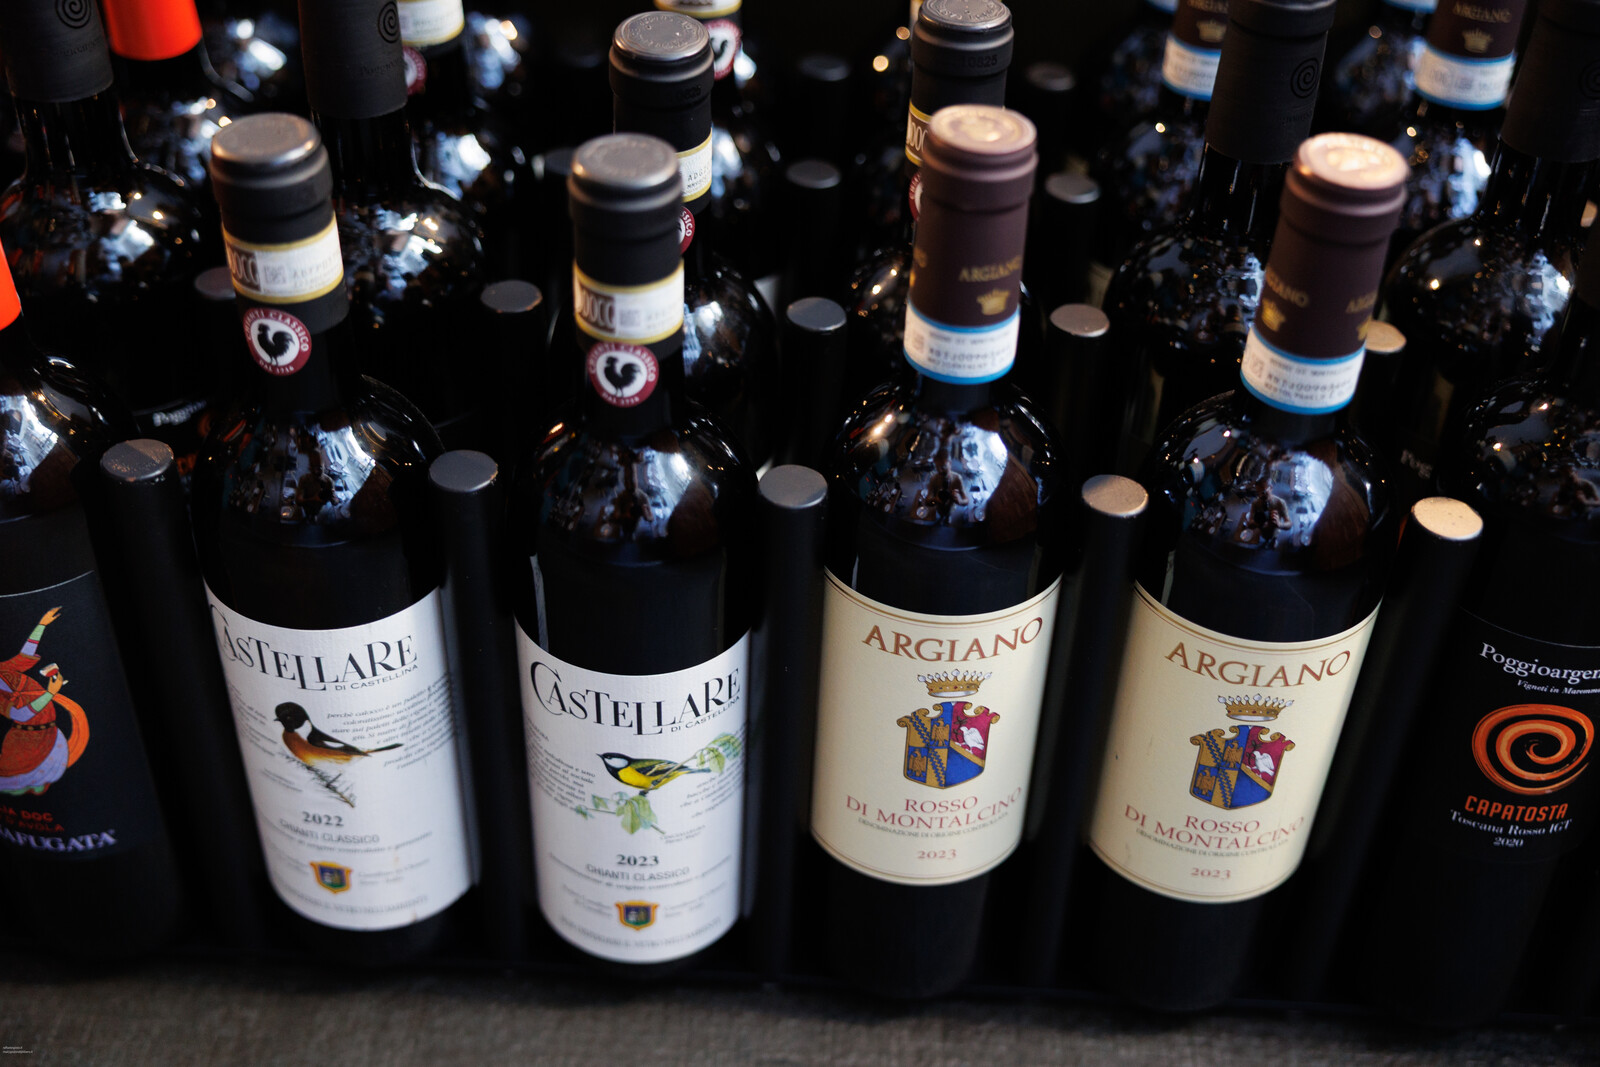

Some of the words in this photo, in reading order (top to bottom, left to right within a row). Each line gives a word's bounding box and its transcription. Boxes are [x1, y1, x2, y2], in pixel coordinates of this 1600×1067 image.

[269, 310, 310, 352] CLASSICO
[619, 343, 657, 382] CLASSICO
[862, 617, 1043, 662] ARGIANO
[1165, 641, 1351, 688] ARGIANO
[350, 664, 419, 690] CASTELLINA
[1517, 679, 1548, 693] Vigneti
[1550, 686, 1559, 694] in
[670, 725, 681, 733] DI
[685, 695, 741, 729] CASTELLINA
[21, 810, 54, 823] DOC
[846, 795, 868, 816] DI
[877, 787, 1022, 829] MONTALCINO
[905, 796, 978, 814] ROSSO
[1464, 795, 1569, 822] CAPATOSTA
[279, 818, 319, 840] CHIANTI
[322, 833, 381, 844] CLASSICO
[303, 811, 344, 827] 2022
[858, 817, 920, 839] DENOMINAZIONE
[1125, 804, 1147, 827] DI
[1154, 816, 1304, 849] MONTALCINO
[1185, 815, 1260, 833] ROSSO
[1450, 809, 1504, 834] Toscana
[1508, 824, 1546, 836] Rosso
[1493, 836, 1524, 848] 2020
[616, 854, 660, 867] 2023
[917, 849, 957, 860] 2023
[586, 863, 630, 882] CHIANTI
[633, 866, 691, 882] CLASSICO
[1191, 867, 1231, 880] 2023
